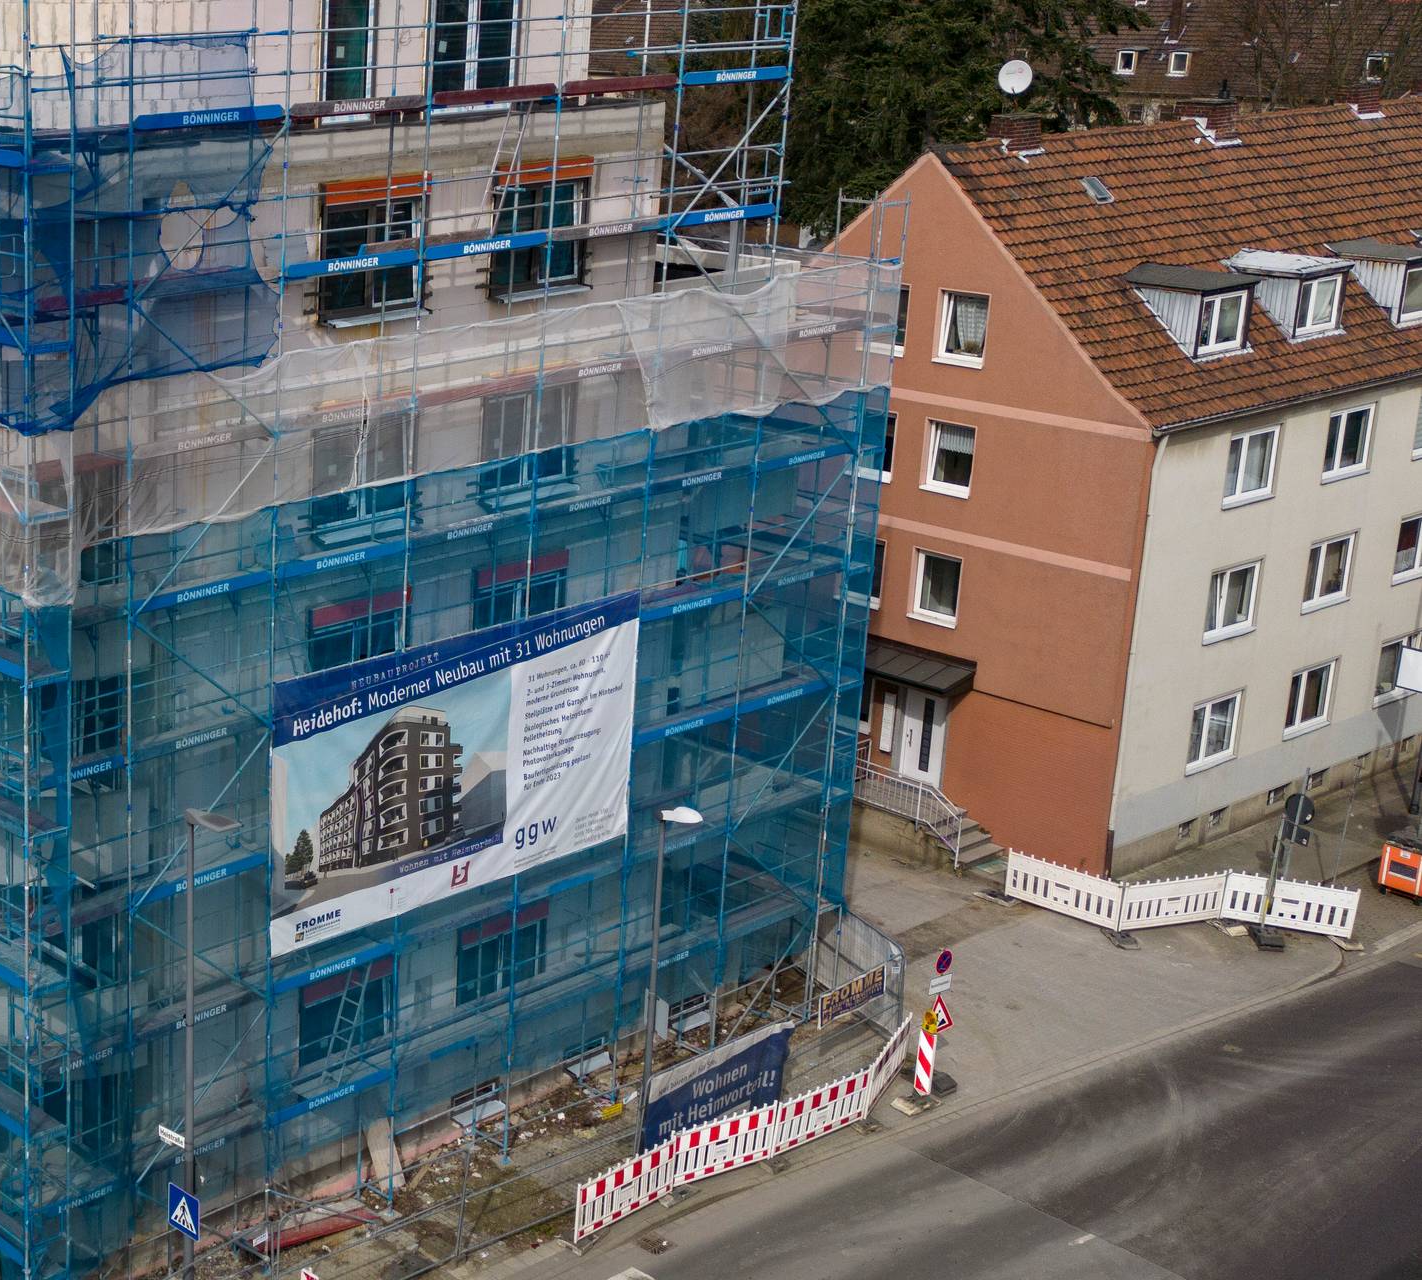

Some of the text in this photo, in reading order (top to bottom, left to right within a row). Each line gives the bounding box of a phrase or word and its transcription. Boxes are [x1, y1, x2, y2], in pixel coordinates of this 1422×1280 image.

[716, 70, 756, 82] BÖNNINGER
[333, 99, 386, 112] BÖNNINGER
[182, 111, 240, 126] BÖNNINGER
[704, 209, 745, 222] BÖNNINGER
[589, 223, 633, 237] BÖNNINGER
[463, 239, 511, 254] BÖNNINGER
[328, 256, 379, 272] BÖNNINGER
[799, 323, 837, 338] BÖNNINGER
[692, 343, 732, 357] BÖNNINGER
[578, 362, 622, 377] BÖNNINGER
[178, 433, 232, 451] BÖNNINGER
[788, 451, 825, 465] BÖNNINGER
[682, 471, 722, 487] BÖNNINGER
[569, 496, 612, 512] BÖNNINGER
[447, 521, 493, 539] BÖNNINGER
[316, 552, 366, 570] BÖNNINGER
[177, 583, 230, 602] BÖNNINGER
[673, 597, 712, 614] BÖNNINGER
[293, 615, 605, 737] Heidehof: Moderner Neubau mit 31 Wohnungen
[352, 652, 439, 690] NEUBAUPROJEKT
[526, 694, 549, 707] moderne
[767, 688, 804, 705] BÖNNINGER
[665, 719, 704, 736] BÖNNINGER
[175, 727, 228, 749] BÖNNINGER
[176, 868, 227, 892] BÖNINGER
[295, 909, 342, 932] FROMME
[309, 957, 357, 980] BÖNNINGER
[822, 966, 883, 1010] FROMME
[176, 1004, 227, 1029] BNINGER
[692, 1063, 748, 1099] Wohnen
[308, 1084, 355, 1110] BÖNNINGER
[658, 1112, 684, 1136] mit
